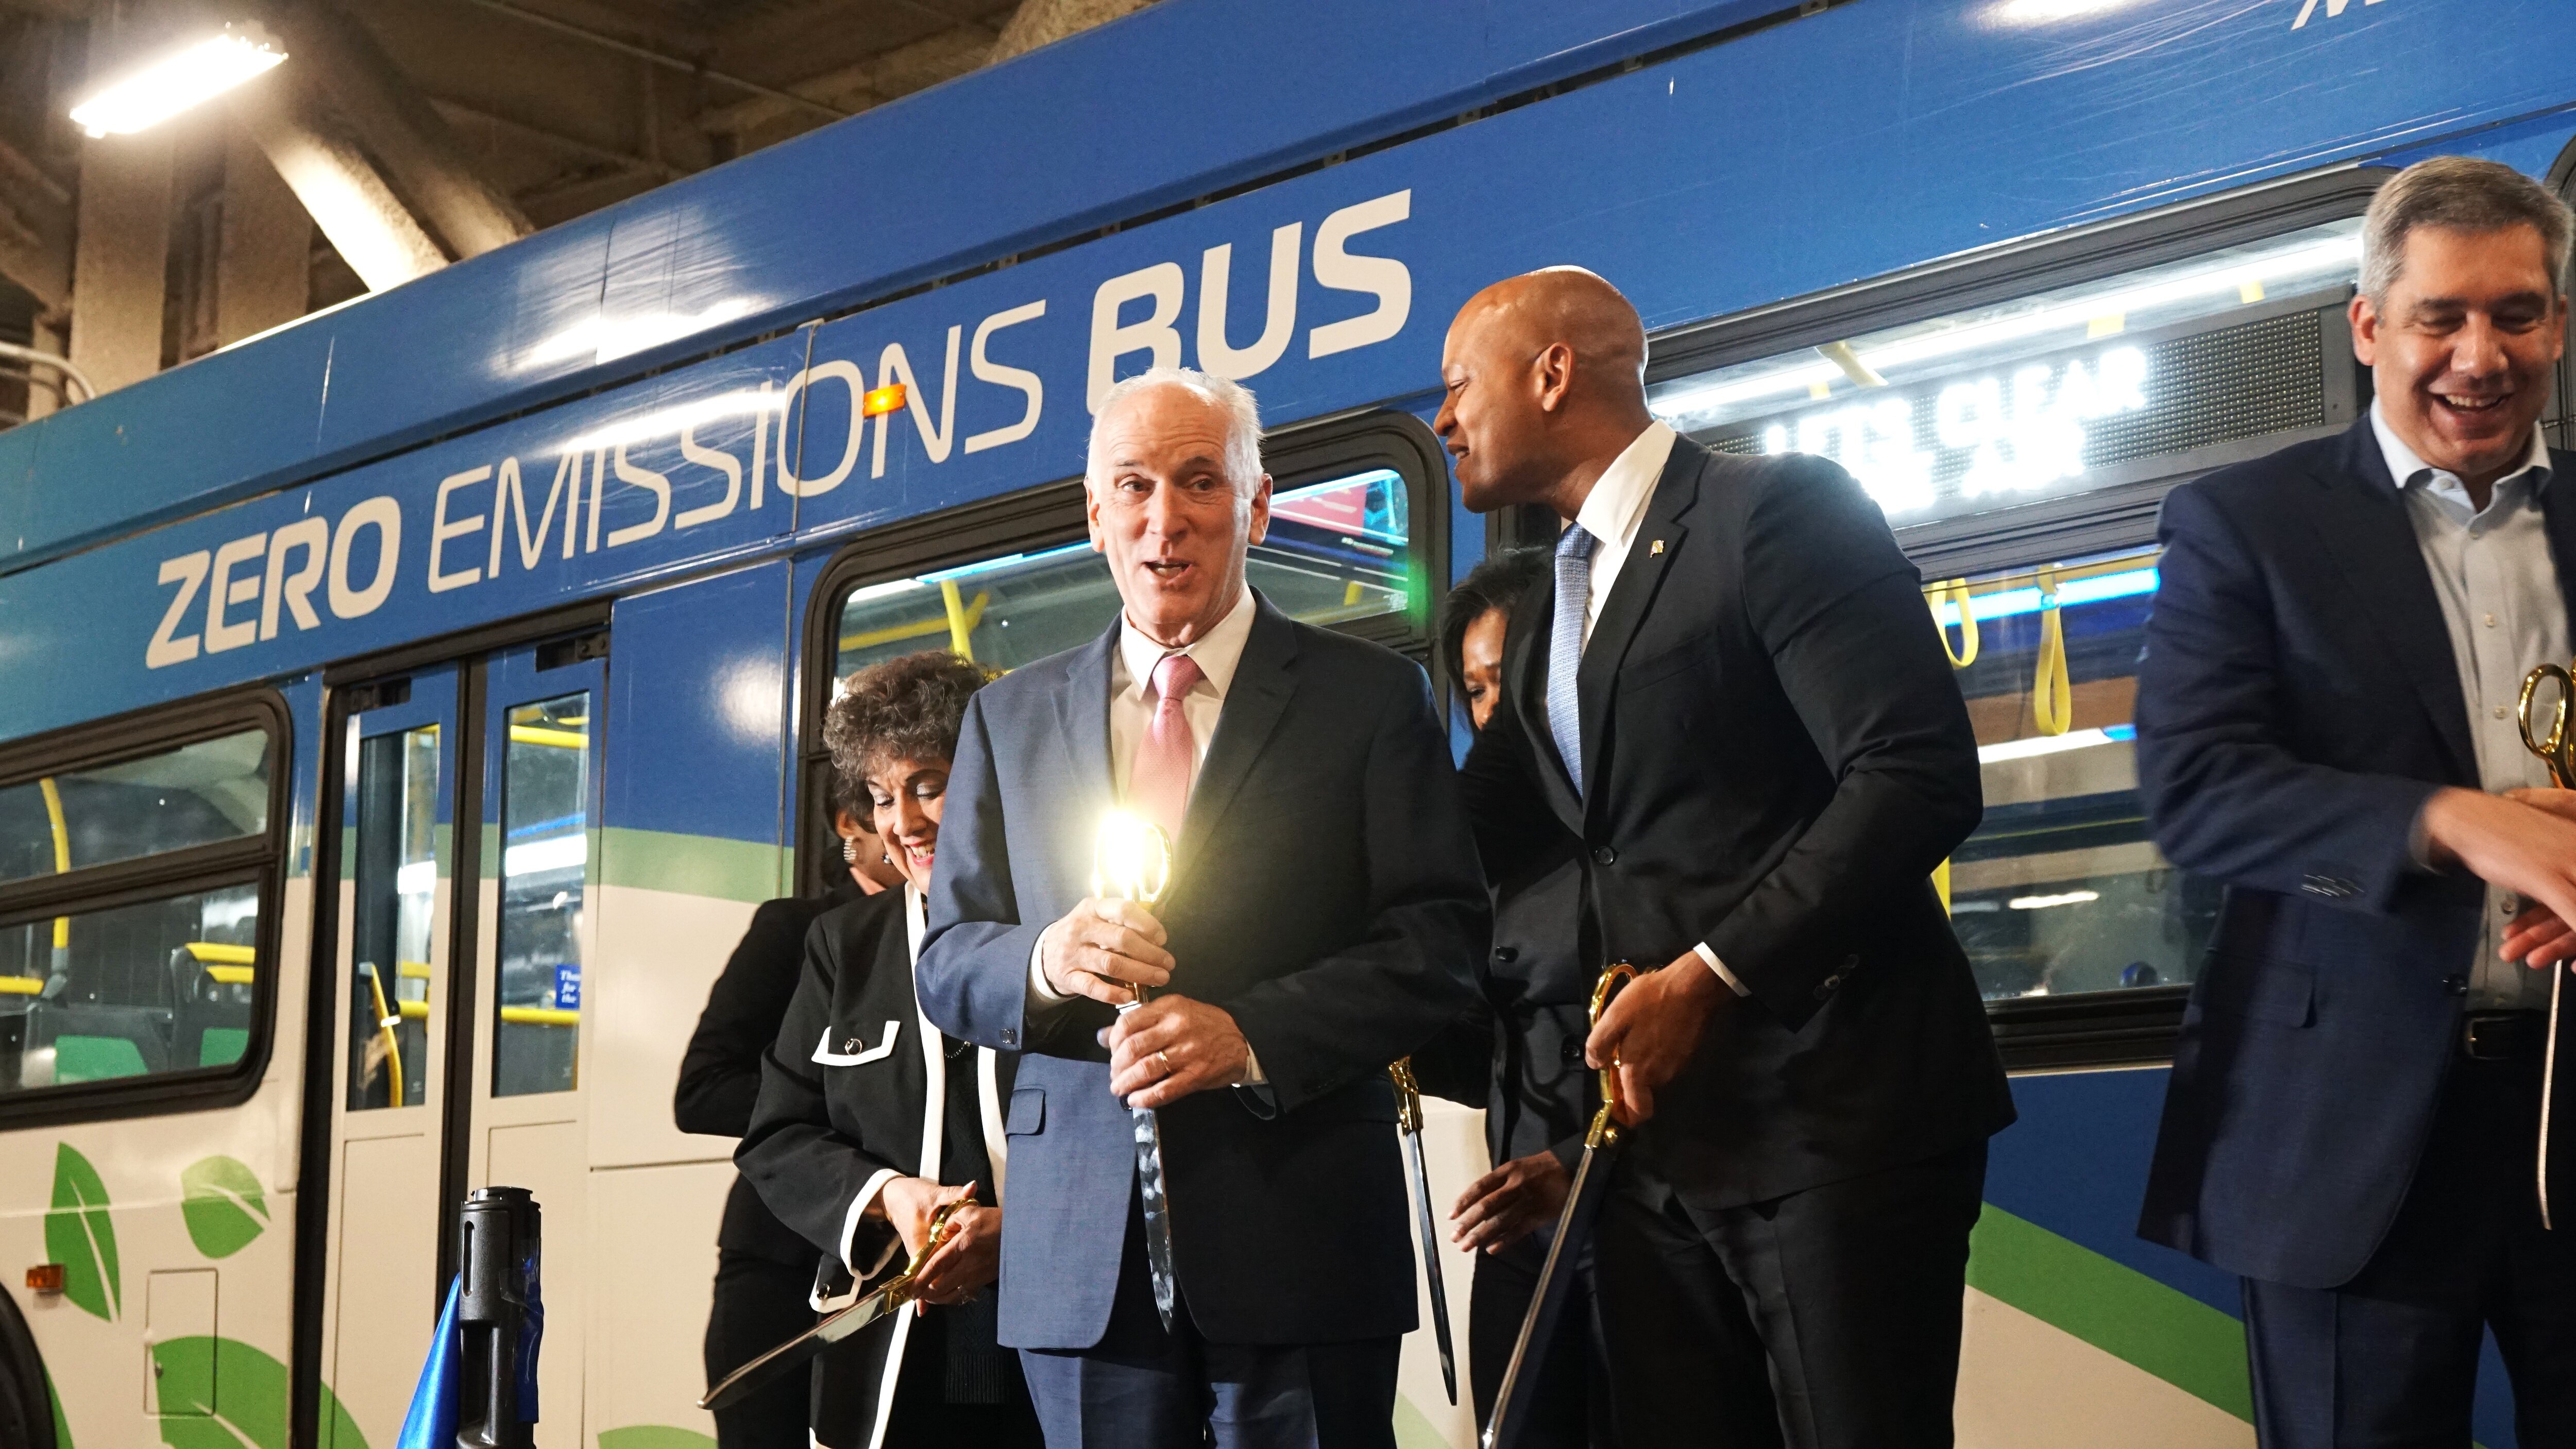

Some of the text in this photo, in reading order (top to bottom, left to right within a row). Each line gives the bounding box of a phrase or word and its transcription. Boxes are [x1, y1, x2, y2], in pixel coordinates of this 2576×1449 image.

[146, 189, 1411, 669] ZERO EMISSIONS BUS
[1937, 347, 2145, 447] CLEAR
